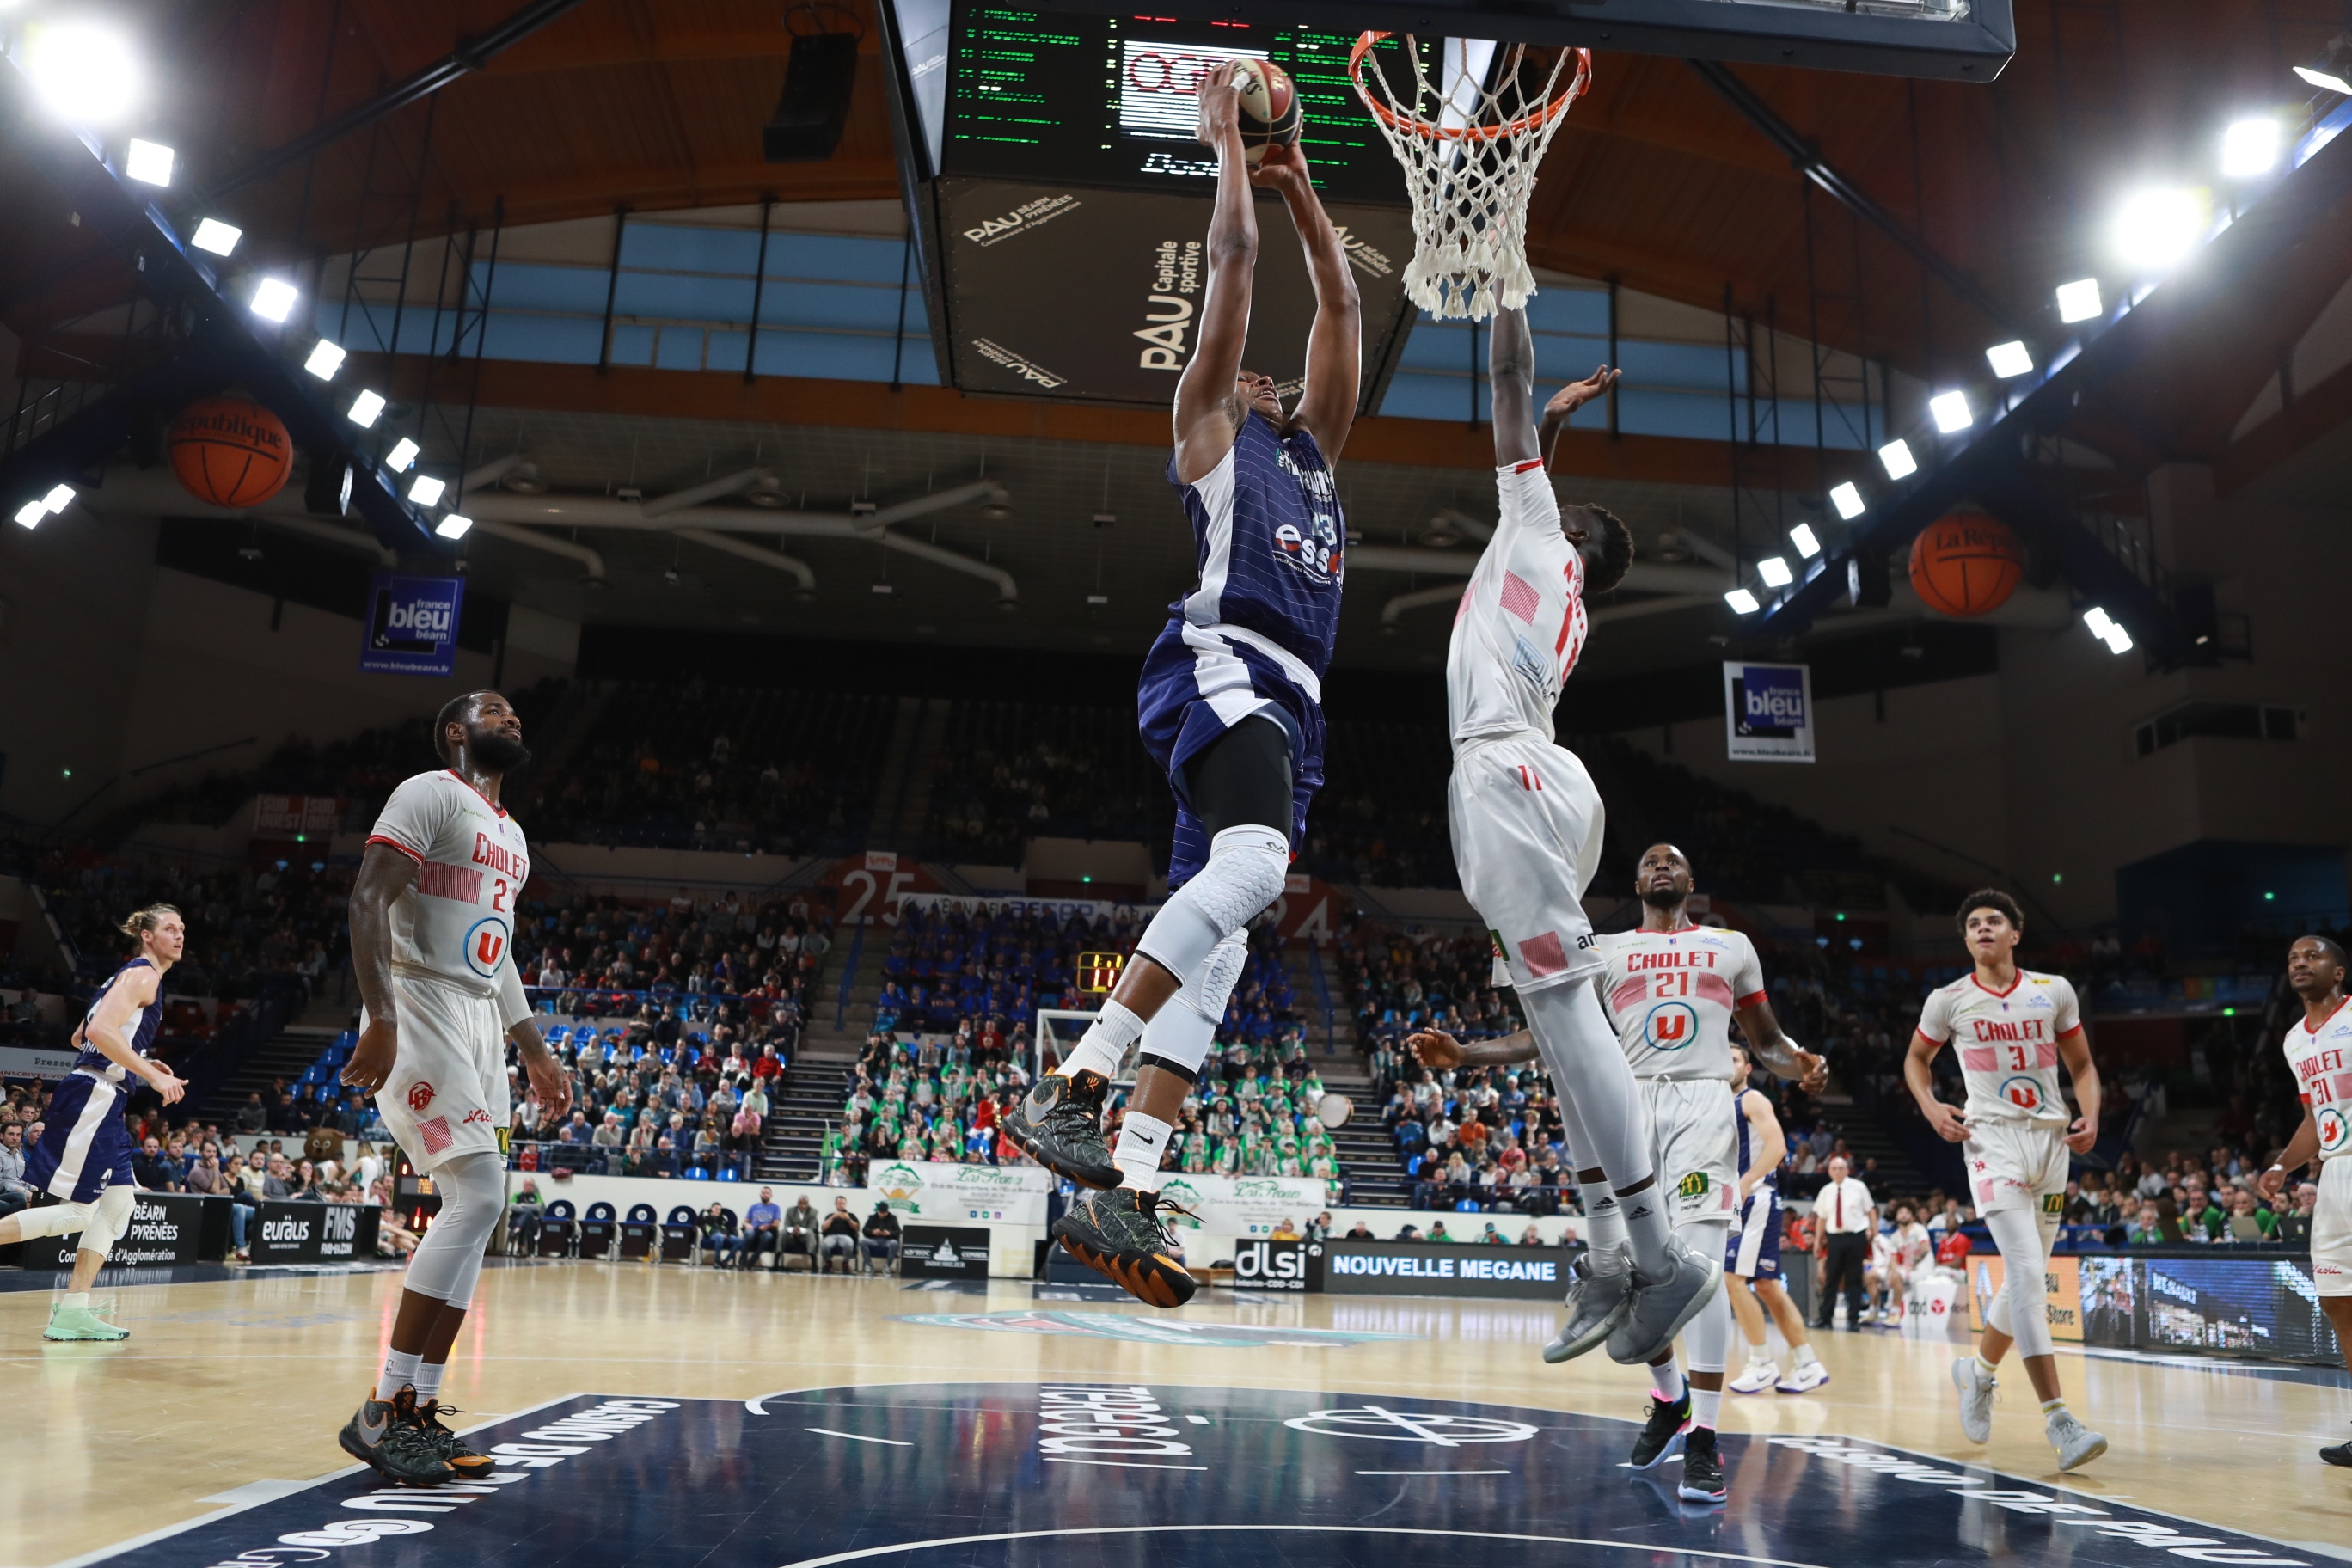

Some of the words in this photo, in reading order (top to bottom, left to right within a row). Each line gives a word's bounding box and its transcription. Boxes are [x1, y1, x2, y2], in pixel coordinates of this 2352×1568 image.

[963, 211, 1023, 242] PAU
[1332, 226, 1364, 249] AU
[1152, 241, 1179, 292] Capitale
[1179, 242, 1201, 293] sportive
[1133, 295, 1193, 371] PAU
[1006, 362, 1061, 388] PAU
[389, 602, 450, 630] bleu
[416, 599, 451, 609] france
[416, 629, 447, 640] béarn
[1747, 689, 1803, 716] bleu
[472, 831, 527, 884] CHOLET
[842, 869, 915, 928] 25
[1627, 951, 1718, 972] CHOLET
[1656, 971, 1688, 998] 21
[1973, 1020, 2043, 1042] CHOLET
[34, 1057, 72, 1067] Presse
[2008, 1046, 2026, 1071] 3
[133, 1202, 167, 1221] BÉARN
[322, 1207, 356, 1240] FMS
[131, 1222, 178, 1240] PYRÉNÉES
[115, 1247, 175, 1265] d'Agglomération
[1235, 1242, 1305, 1278] dlsi
[1333, 1255, 1454, 1277] NOUVELLE
[1460, 1259, 1557, 1281] MEGANE
[520, 1400, 682, 1442] CASINO
[1766, 1436, 1986, 1485] CASINO
[1946, 1489, 2113, 1515] DE
[2055, 1519, 2314, 1566] PAU
